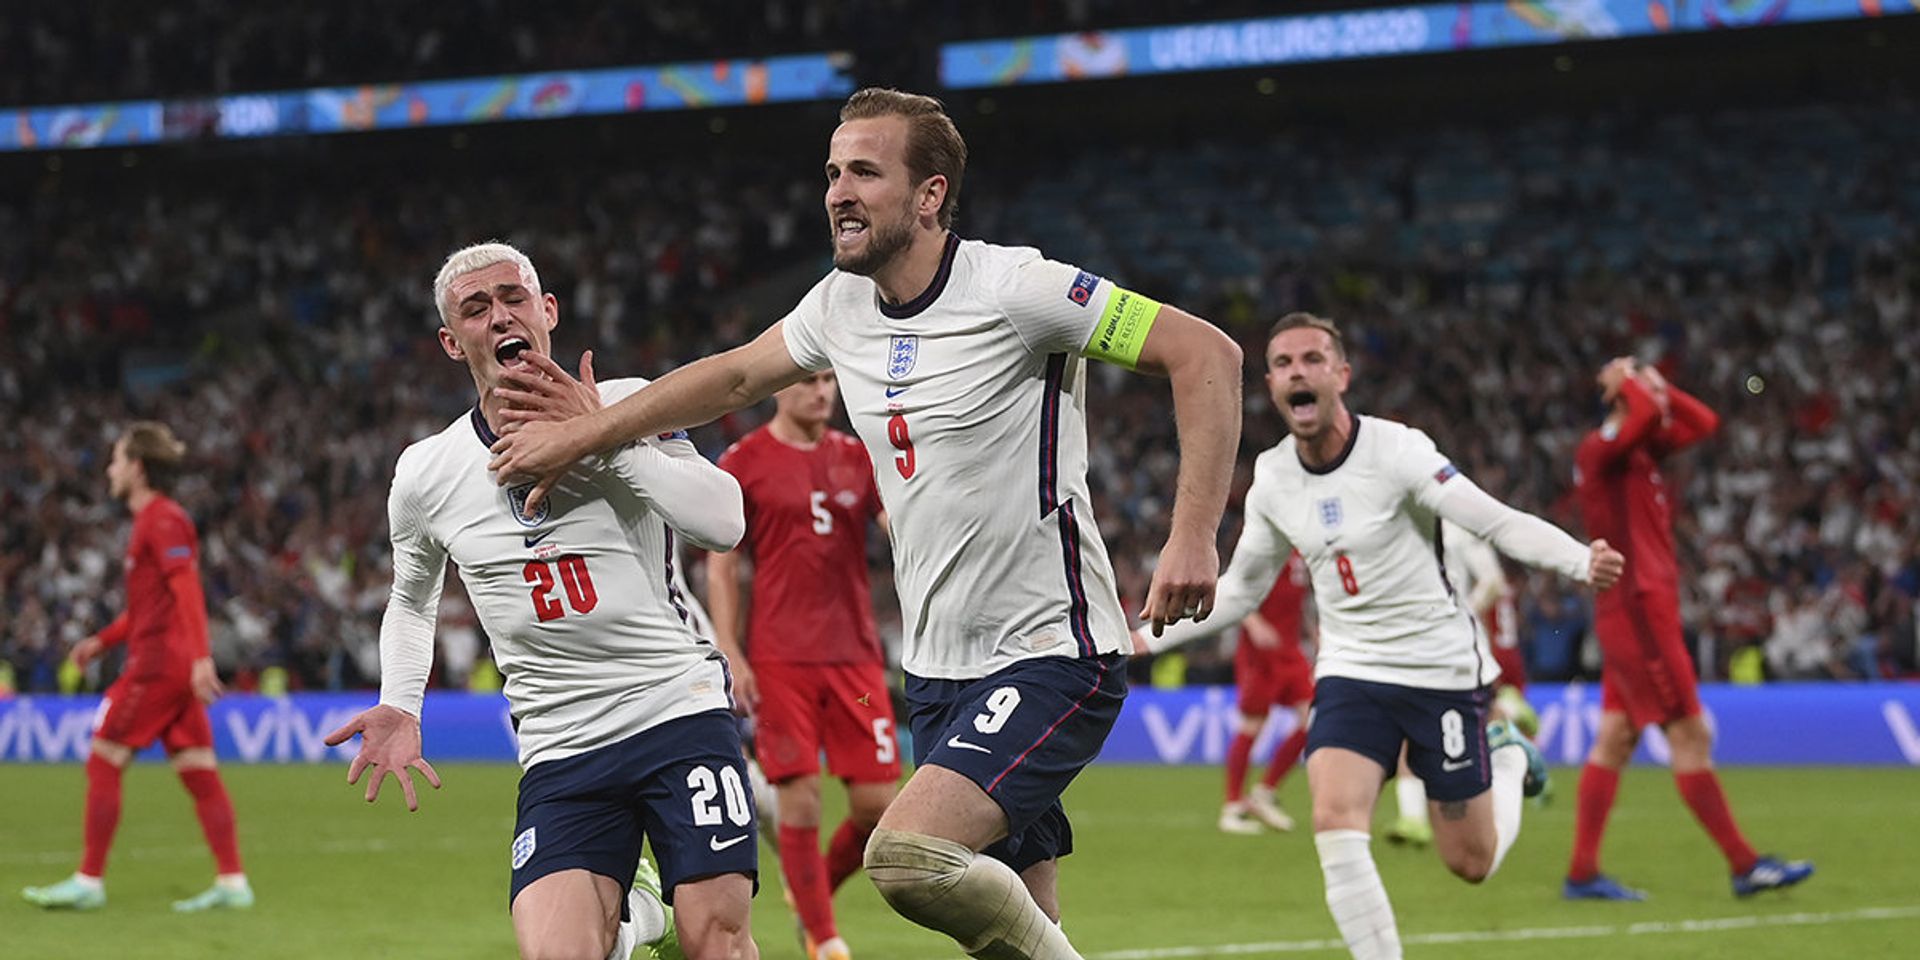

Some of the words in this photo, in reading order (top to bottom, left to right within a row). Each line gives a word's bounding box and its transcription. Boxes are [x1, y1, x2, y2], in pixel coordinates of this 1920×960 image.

[1152, 25, 1236, 68] UEFA
[1242, 16, 1335, 62] EURO
[1338, 9, 1428, 55] 2020
[1121, 301, 1143, 340] RESPECT
[888, 413, 916, 480] 9
[810, 491, 833, 535] 5
[522, 554, 599, 623] 20
[1336, 555, 1360, 596] 8
[973, 686, 1022, 734] 9
[1441, 709, 1466, 758] 8
[872, 717, 895, 764] 5
[686, 765, 751, 827] 20
